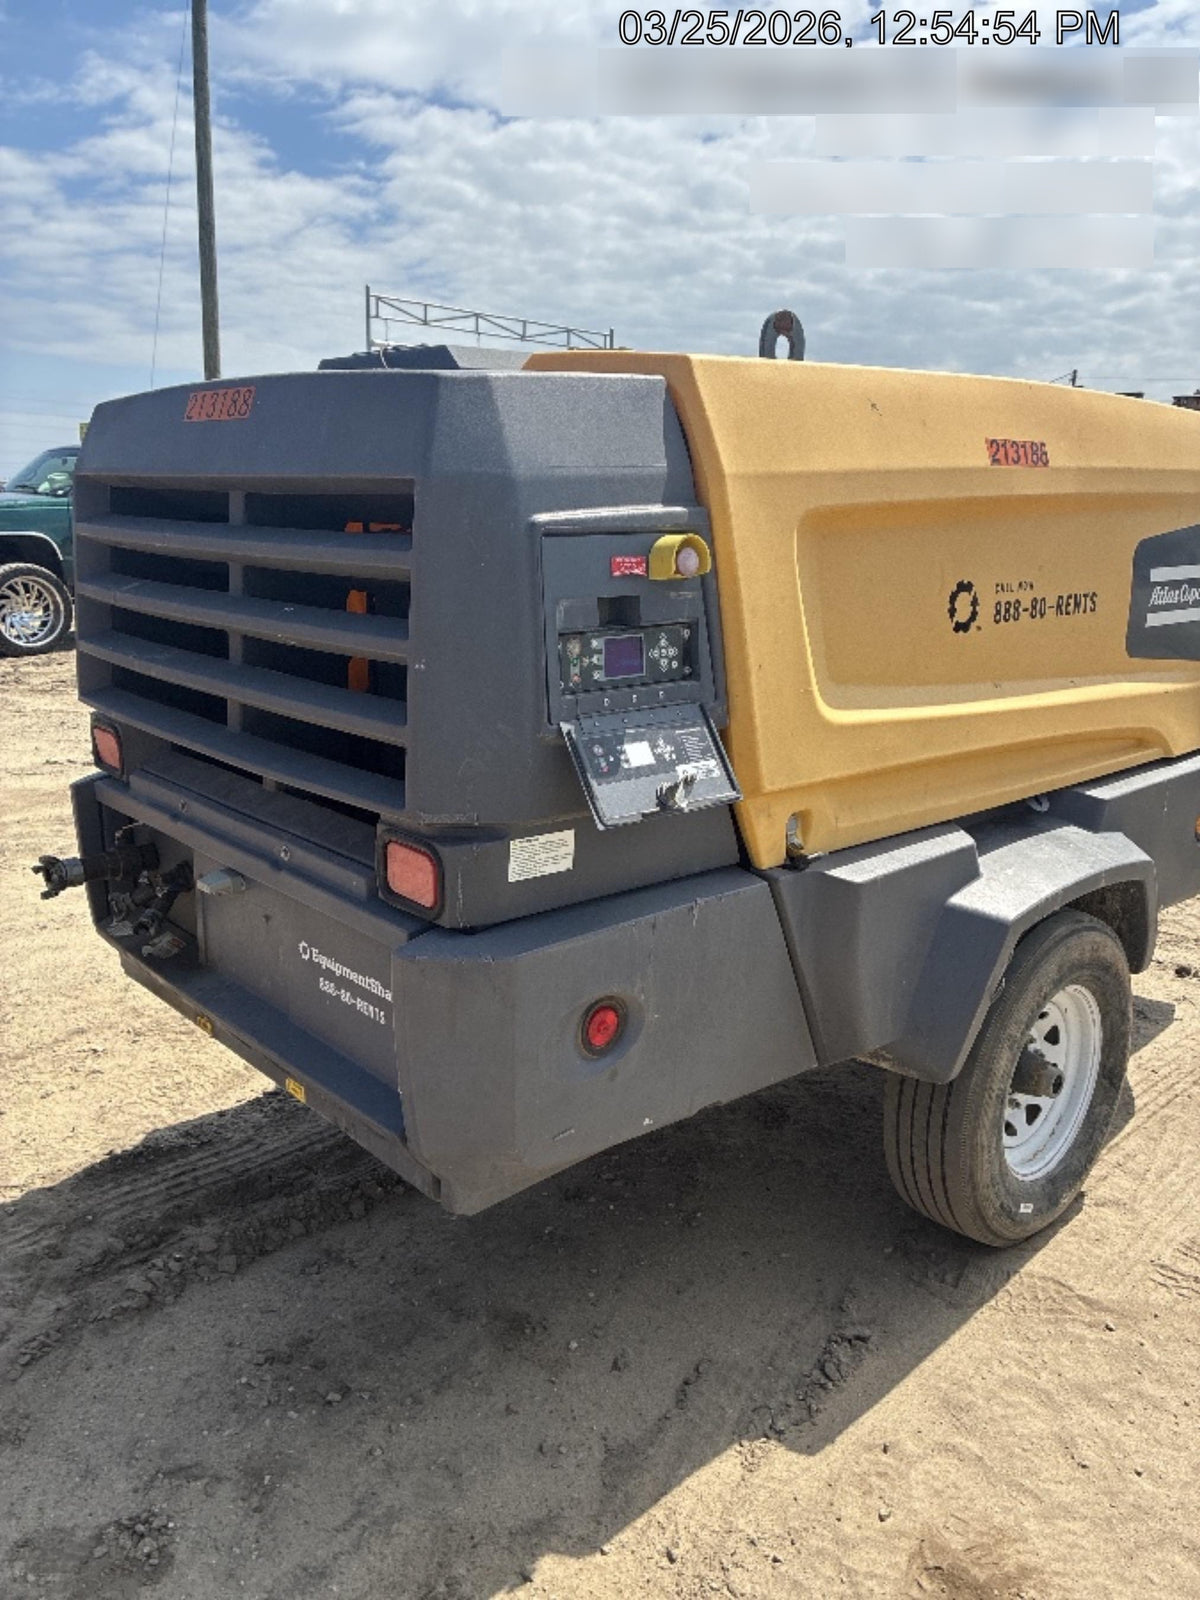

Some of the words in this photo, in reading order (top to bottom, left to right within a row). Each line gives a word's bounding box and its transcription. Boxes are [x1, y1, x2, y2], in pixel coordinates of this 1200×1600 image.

[185, 389, 253, 420] 213188
[994, 592, 1098, 624] 888-80-RENTS
[1148, 586, 1179, 606] Atlas
